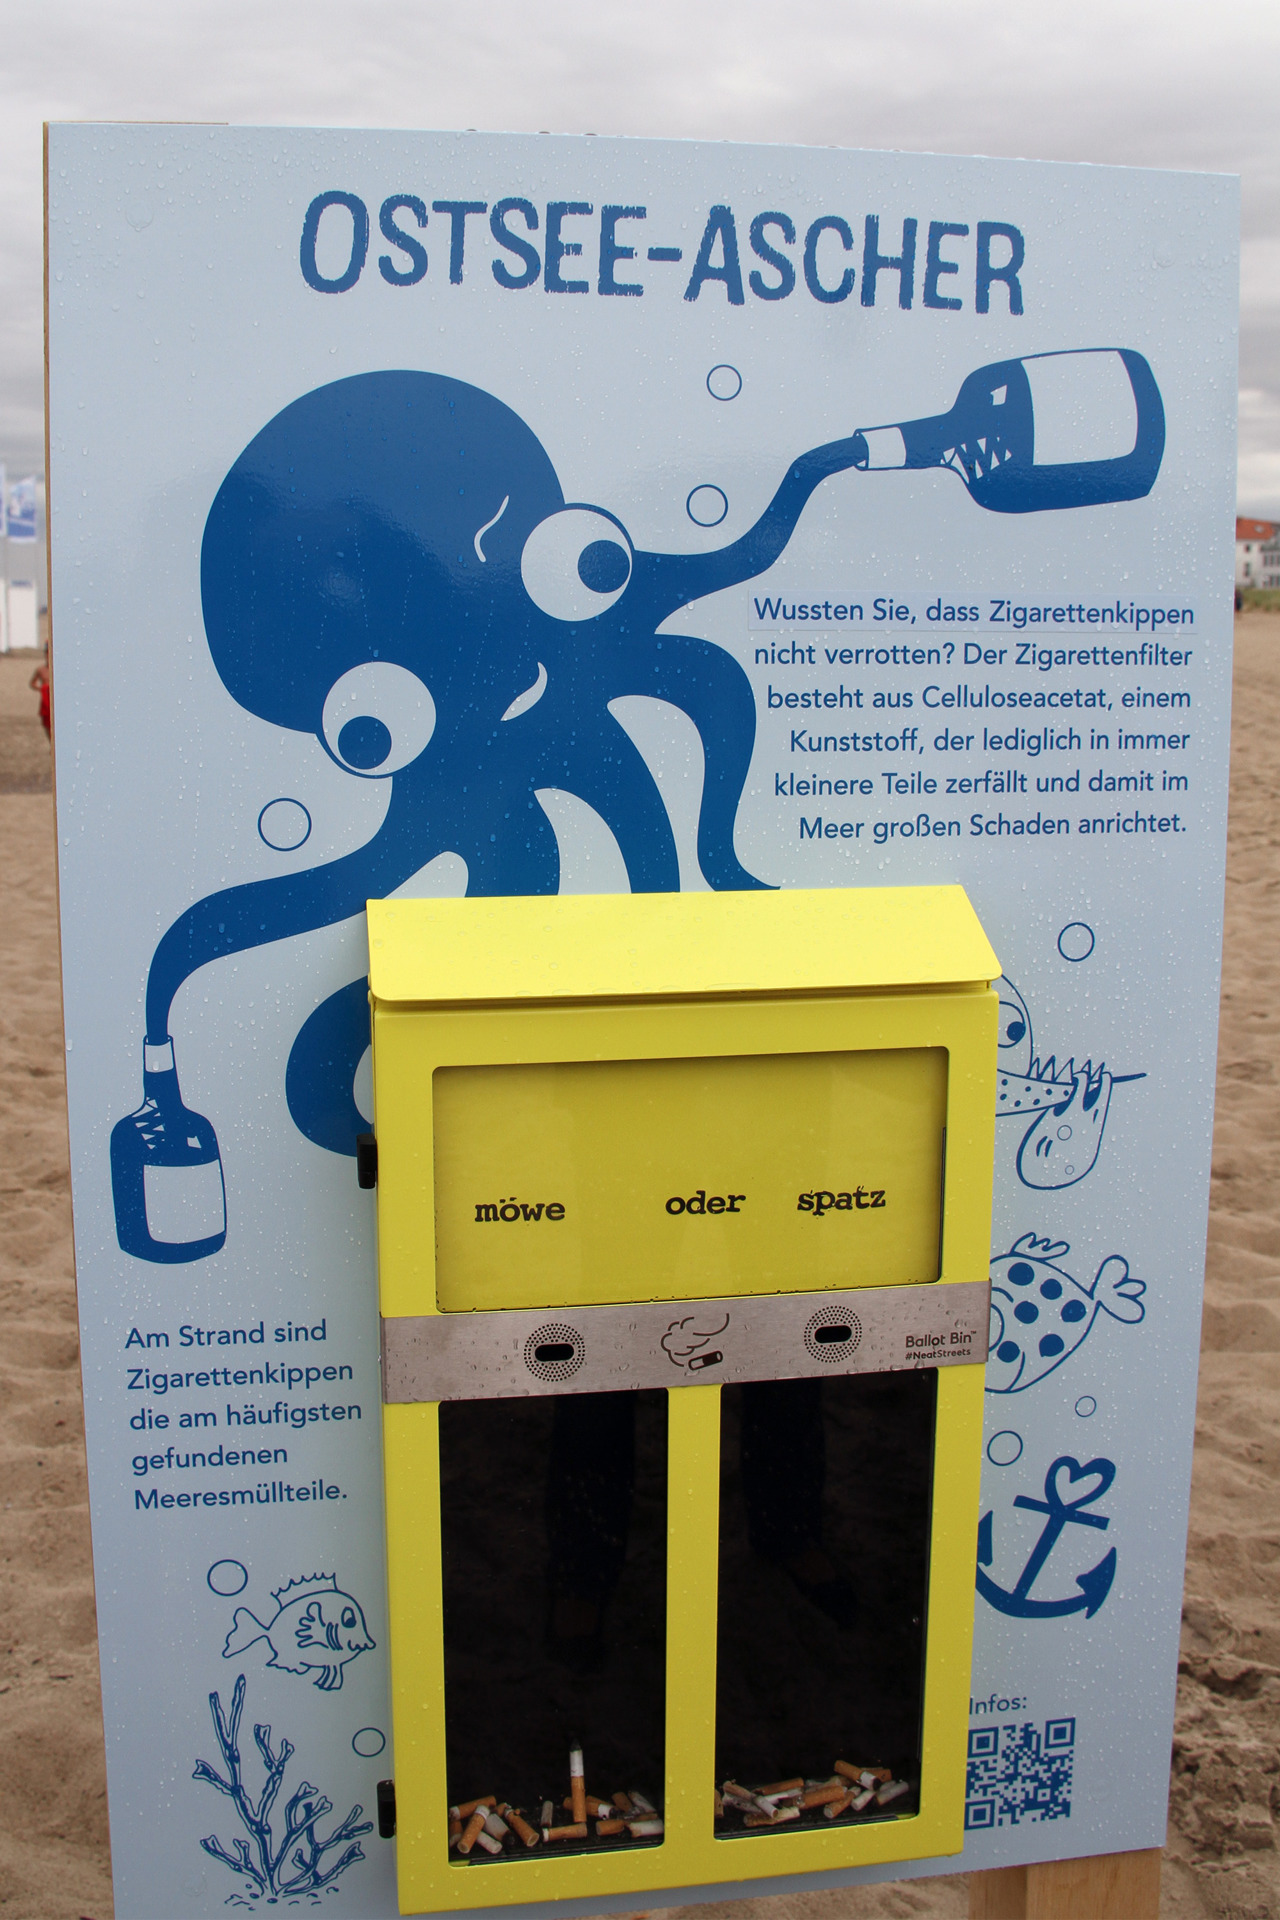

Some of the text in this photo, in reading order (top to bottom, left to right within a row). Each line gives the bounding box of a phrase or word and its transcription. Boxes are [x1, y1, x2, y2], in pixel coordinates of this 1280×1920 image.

[299, 190, 1025, 316] OSTSEE-ASCHER
[753, 598, 1194, 631] Wussten Sie, dass Zigarettenkippen
[754, 642, 1192, 671] nicht verrotten? Der Zigarettenfilter
[768, 685, 1191, 711] besteht aus Celluloseacetat, einem
[790, 728, 1190, 757] Kunststoff, der lediglich in immer
[774, 770, 1188, 796] kleinere Teile zerfällt und damit im
[800, 811, 1186, 844] Meer großen Schaden anrichtet.
[474, 1186, 886, 1222] möwe oder spatz
[125, 1318, 327, 1349] Am Strand sind
[905, 1334, 945, 1348] Ballot
[905, 1349, 971, 1360] #NeatStreets
[126, 1362, 353, 1394] Zigarettenkippen
[130, 1402, 362, 1429] die am häufigsten
[132, 1445, 288, 1476] gefundenen
[134, 1479, 347, 1509] Meeresmüllteile.
[969, 1693, 1027, 1715] Infos:
